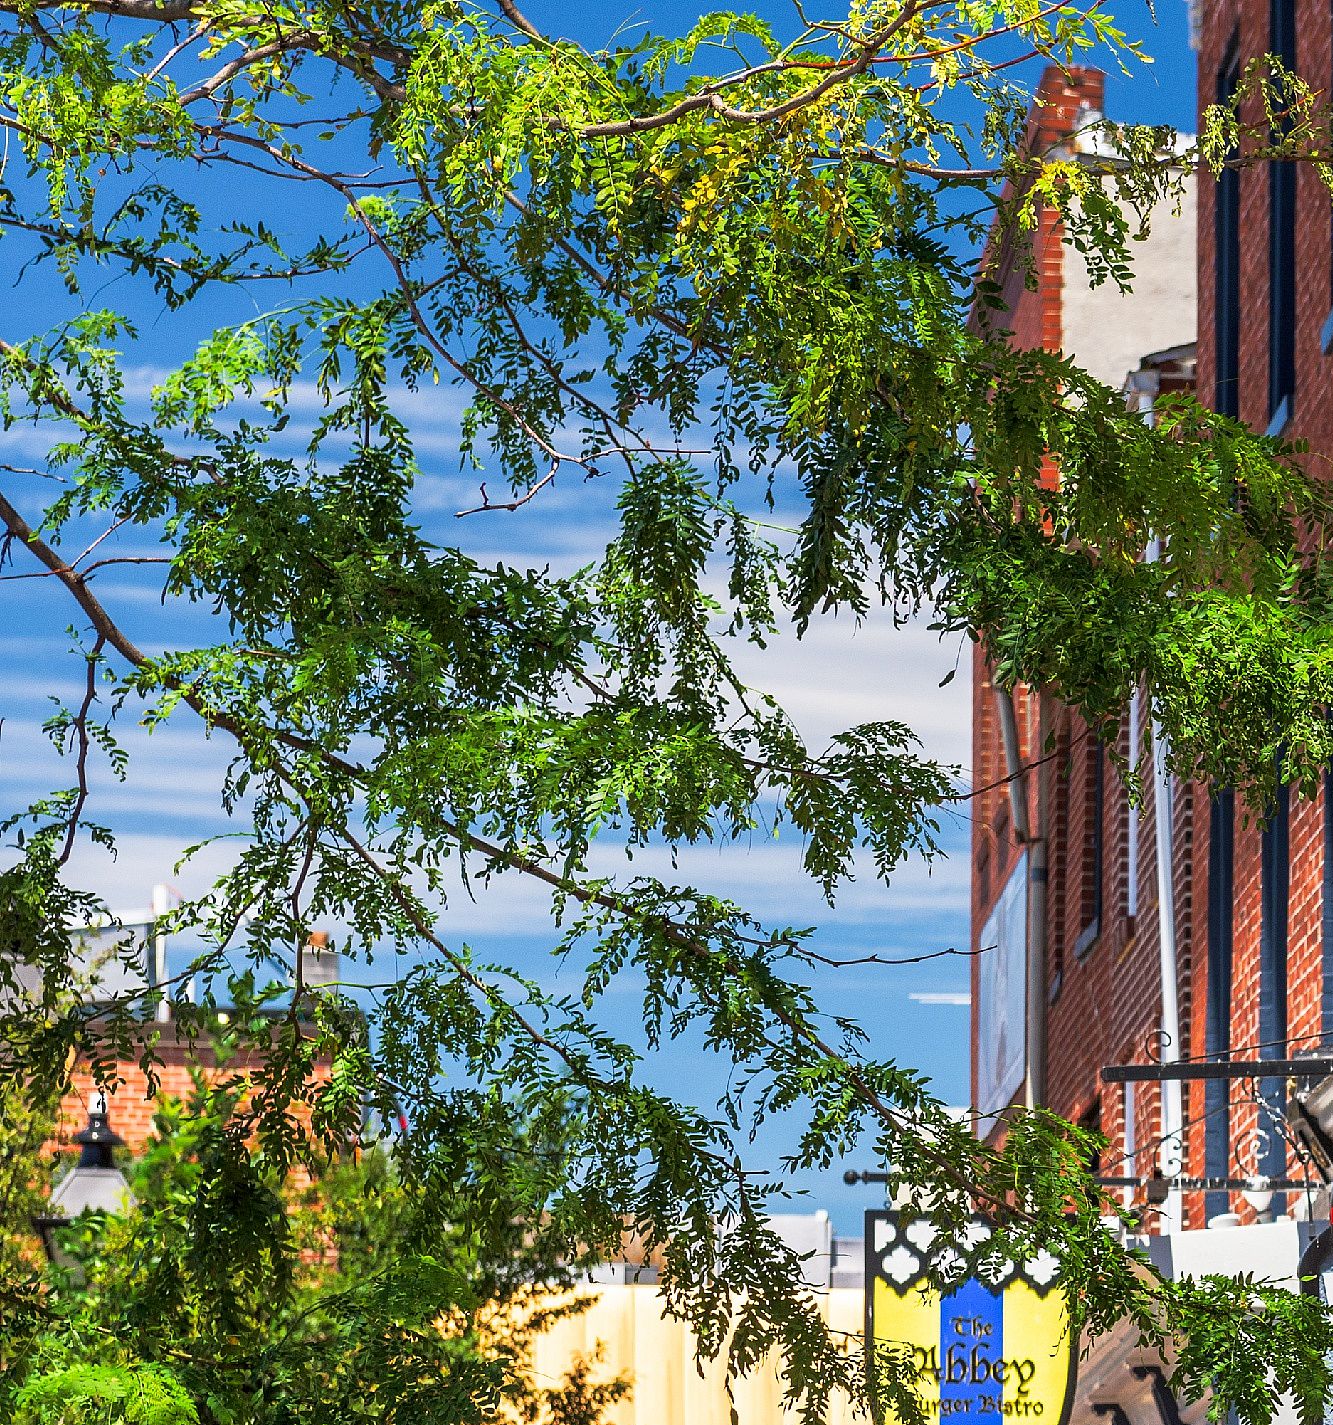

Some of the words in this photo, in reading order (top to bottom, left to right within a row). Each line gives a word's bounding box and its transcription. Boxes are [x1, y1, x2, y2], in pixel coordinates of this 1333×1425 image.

[951, 1315, 993, 1339] The
[914, 1342, 1036, 1395] Abbey
[917, 1399, 971, 1417] urger
[978, 1394, 1044, 1417] Bistro
